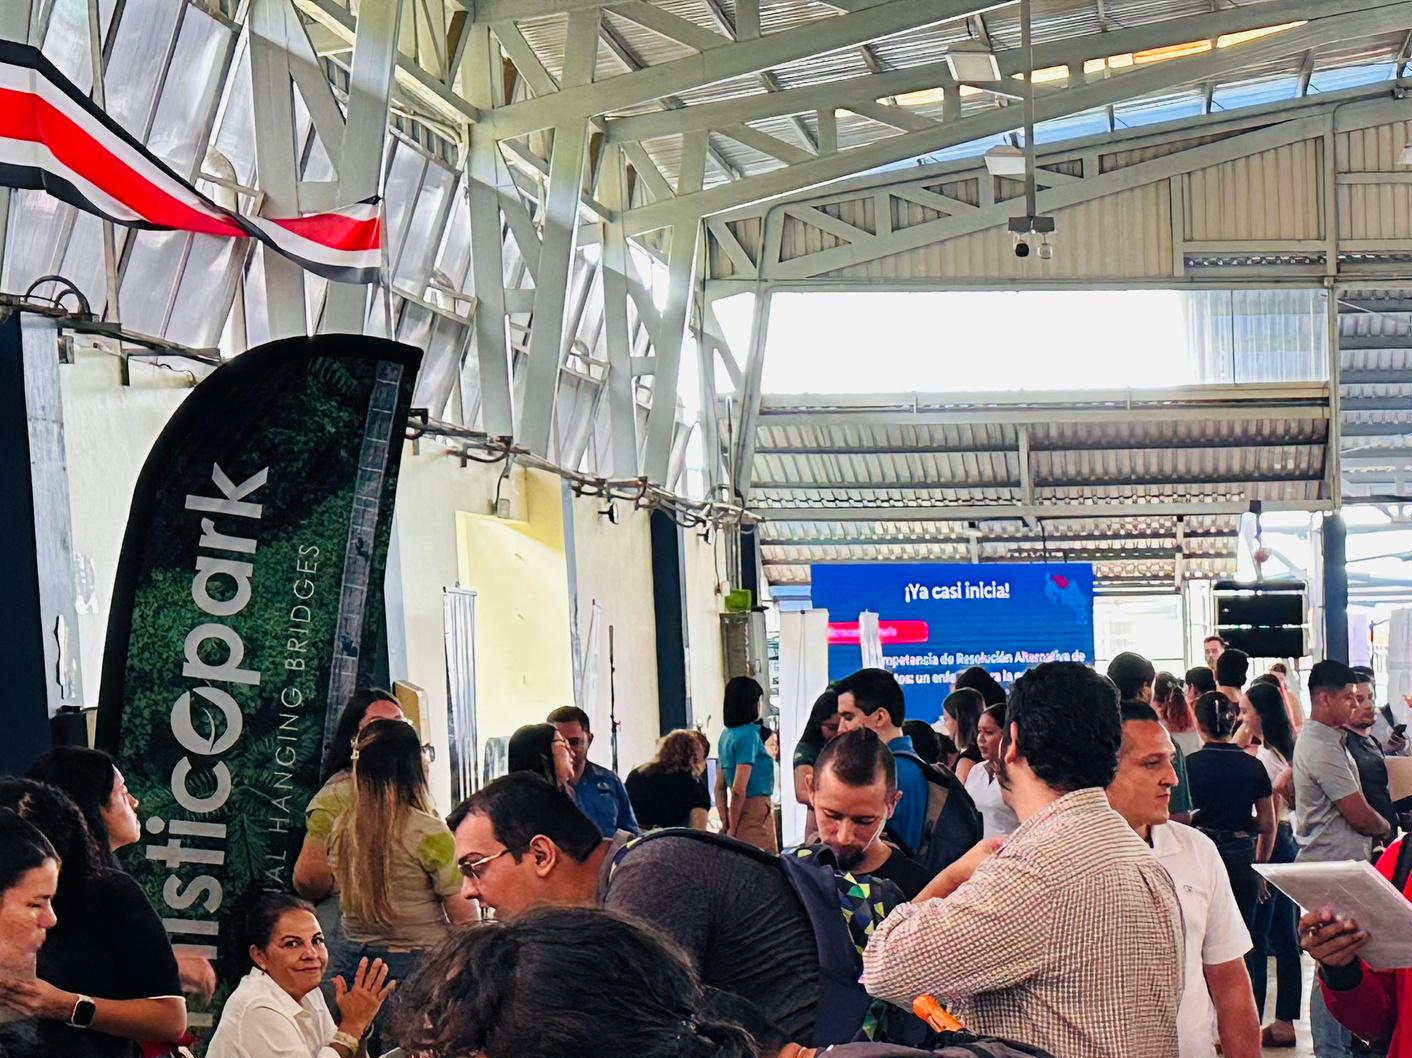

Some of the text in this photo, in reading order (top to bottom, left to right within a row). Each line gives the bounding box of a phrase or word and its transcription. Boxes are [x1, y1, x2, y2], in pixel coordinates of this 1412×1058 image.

[285, 544, 320, 671] BRIDGES
[905, 581, 1010, 603] ¡Ya casi inicia!
[1072, 649, 1086, 662] de
[269, 687, 303, 833] HANGING
